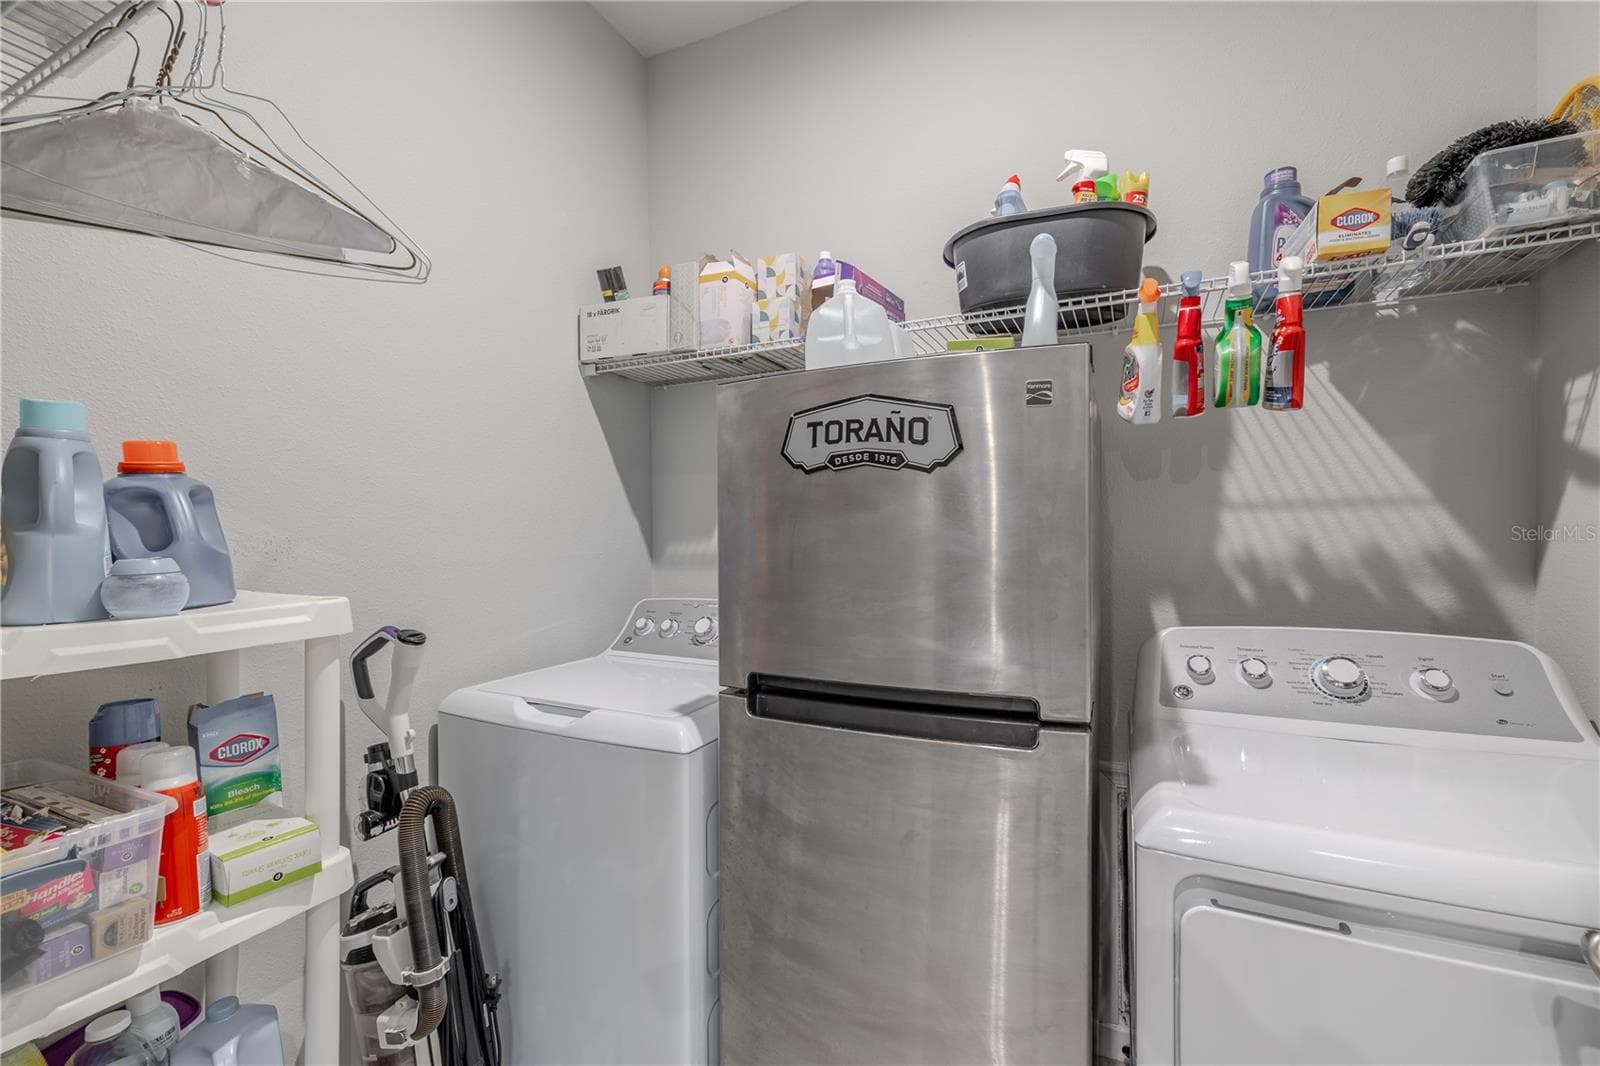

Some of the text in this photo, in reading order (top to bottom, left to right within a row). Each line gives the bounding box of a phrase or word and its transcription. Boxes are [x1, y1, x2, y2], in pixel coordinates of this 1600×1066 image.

[1336, 211, 1375, 226] CLOROX
[1338, 230, 1372, 238] ELIMINATES
[806, 410, 930, 448] TORAÑO
[834, 453, 897, 466] DESDE 1916
[218, 737, 264, 760] CLOROX
[227, 783, 260, 798] Bleach
